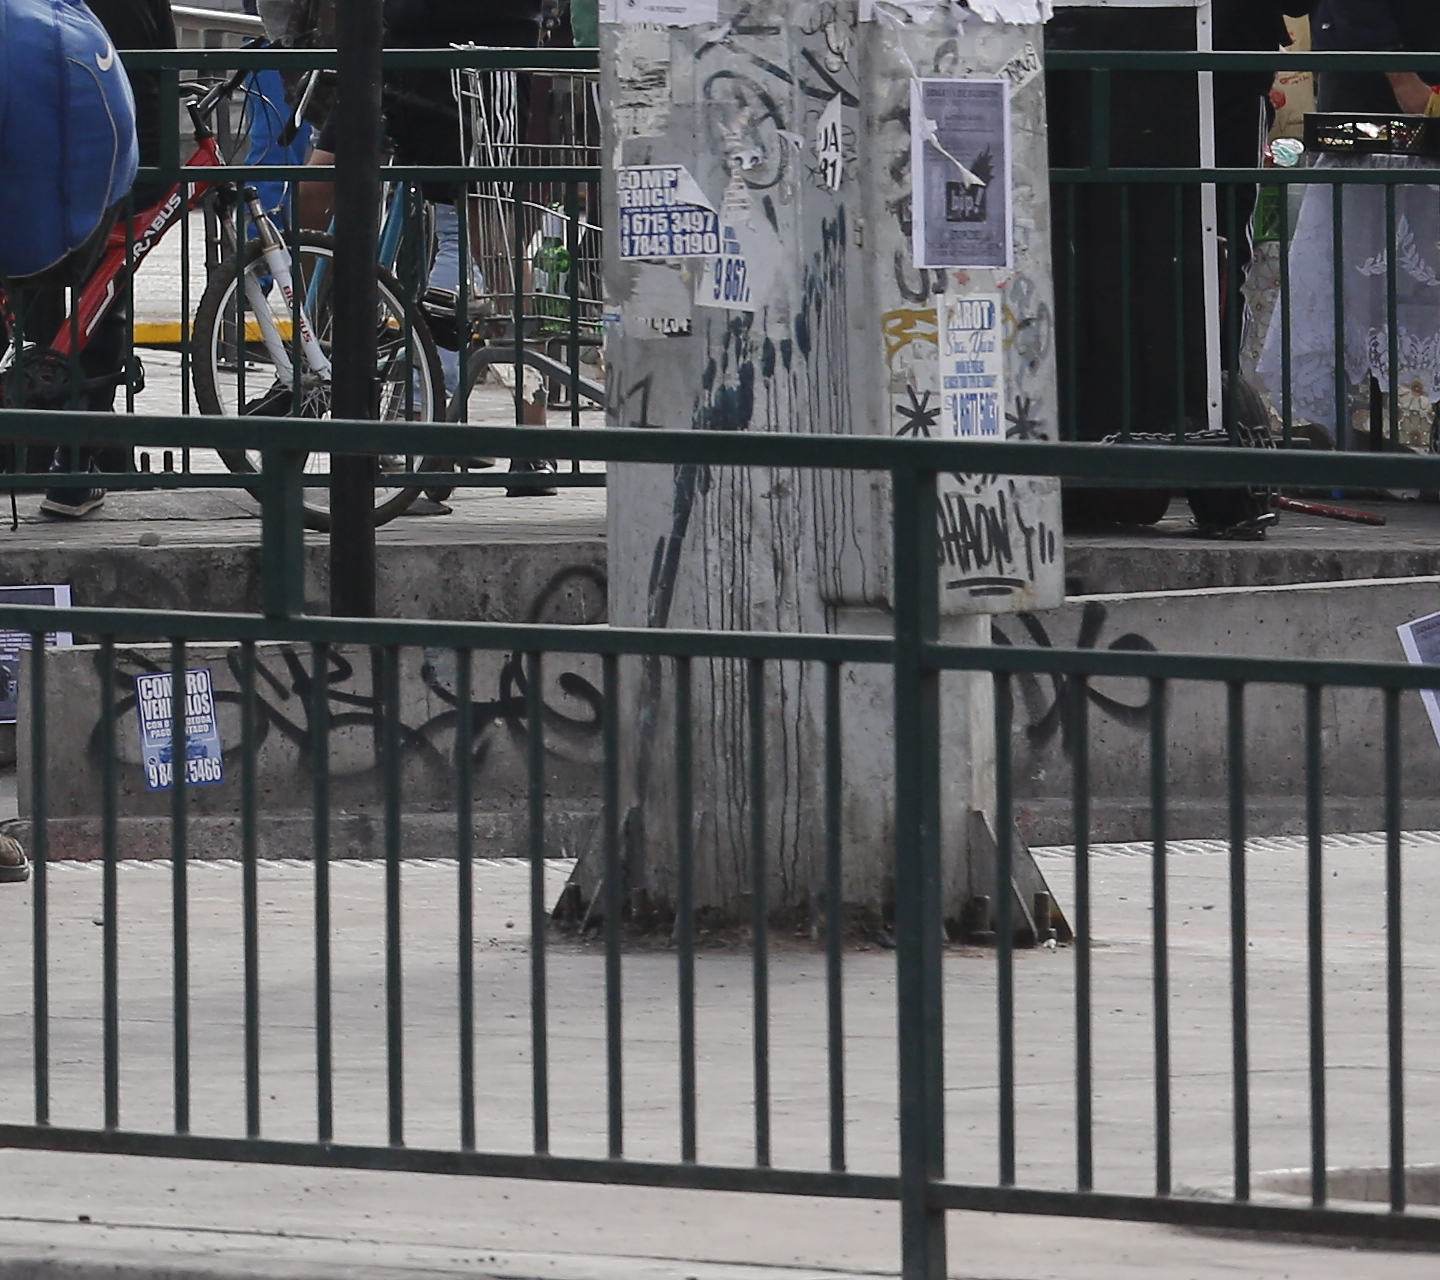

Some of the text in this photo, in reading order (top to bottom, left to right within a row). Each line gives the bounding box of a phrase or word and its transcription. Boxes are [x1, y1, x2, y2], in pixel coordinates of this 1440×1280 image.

[618, 170, 679, 189] COMP
[125, 192, 181, 265] RABUS
[631, 213, 669, 235] 6715
[670, 211, 715, 233] 3497
[631, 235, 671, 256] 7843
[672, 232, 718, 254] 8190
[947, 301, 991, 329] AROT
[190, 758, 221, 783] 5466
